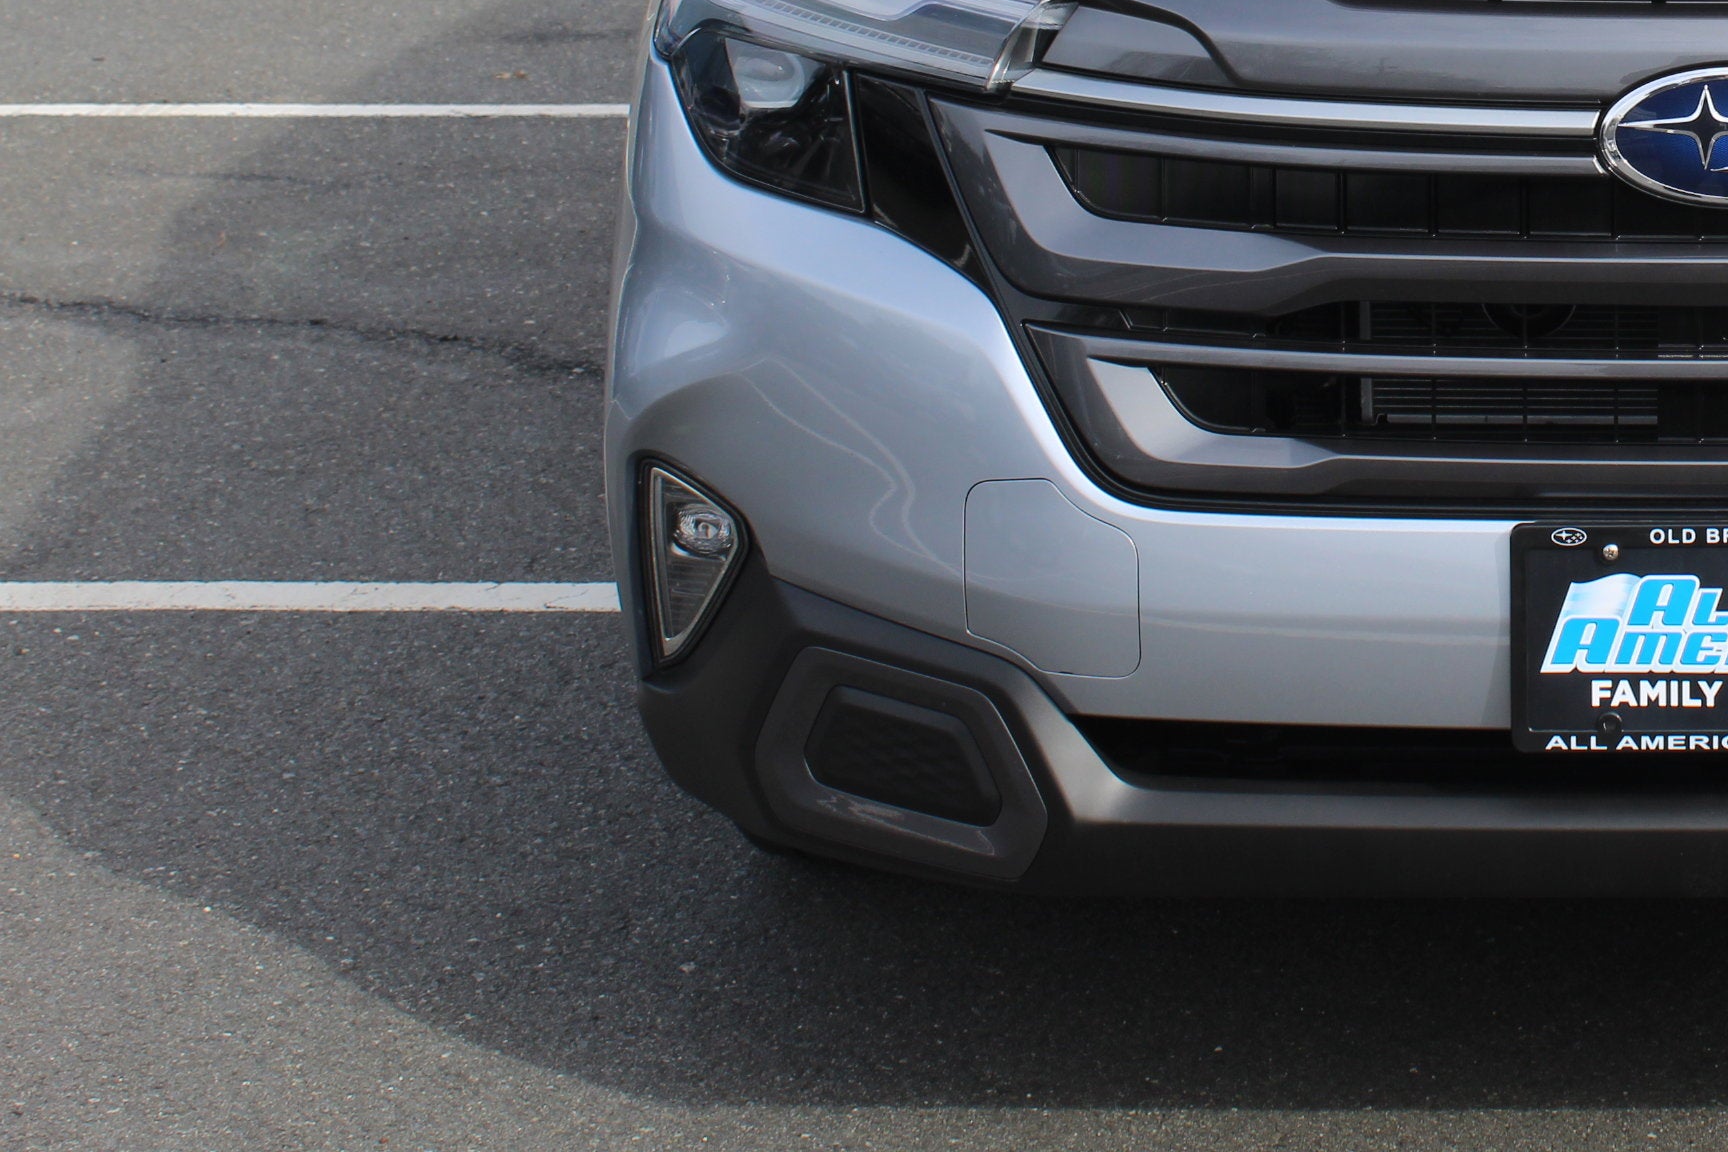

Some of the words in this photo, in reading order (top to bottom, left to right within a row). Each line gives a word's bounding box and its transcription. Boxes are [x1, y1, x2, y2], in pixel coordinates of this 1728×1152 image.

[1649, 527, 1697, 545] OLD
[1591, 680, 1724, 708] FAMILY
[1545, 734, 1608, 750] ALL
